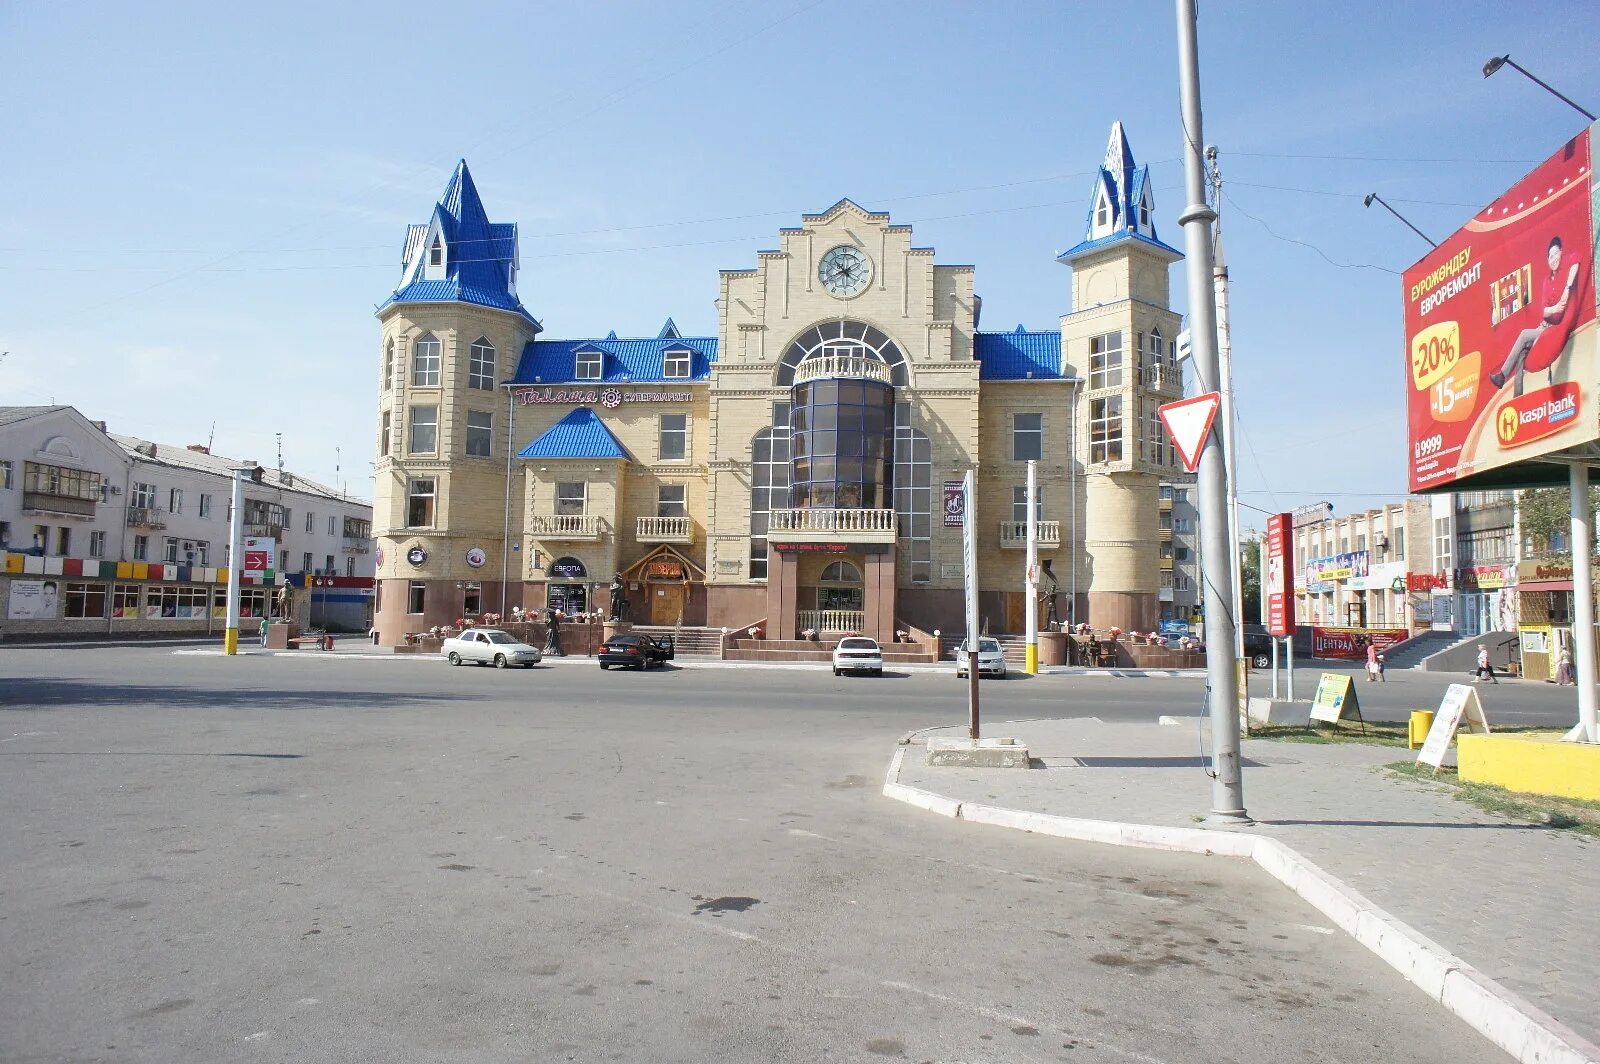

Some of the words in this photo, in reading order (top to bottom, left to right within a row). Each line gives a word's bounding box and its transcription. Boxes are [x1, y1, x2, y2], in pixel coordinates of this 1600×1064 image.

[1411, 246, 1471, 302] ЕУРОЖӨНДЕУ
[1420, 261, 1482, 317] ЕВРОРЕМОНТ
[1436, 376, 1455, 414] 15
[1520, 402, 1547, 425] kaspi
[1548, 393, 1576, 415] bank
[1420, 434, 1442, 456] 9999
